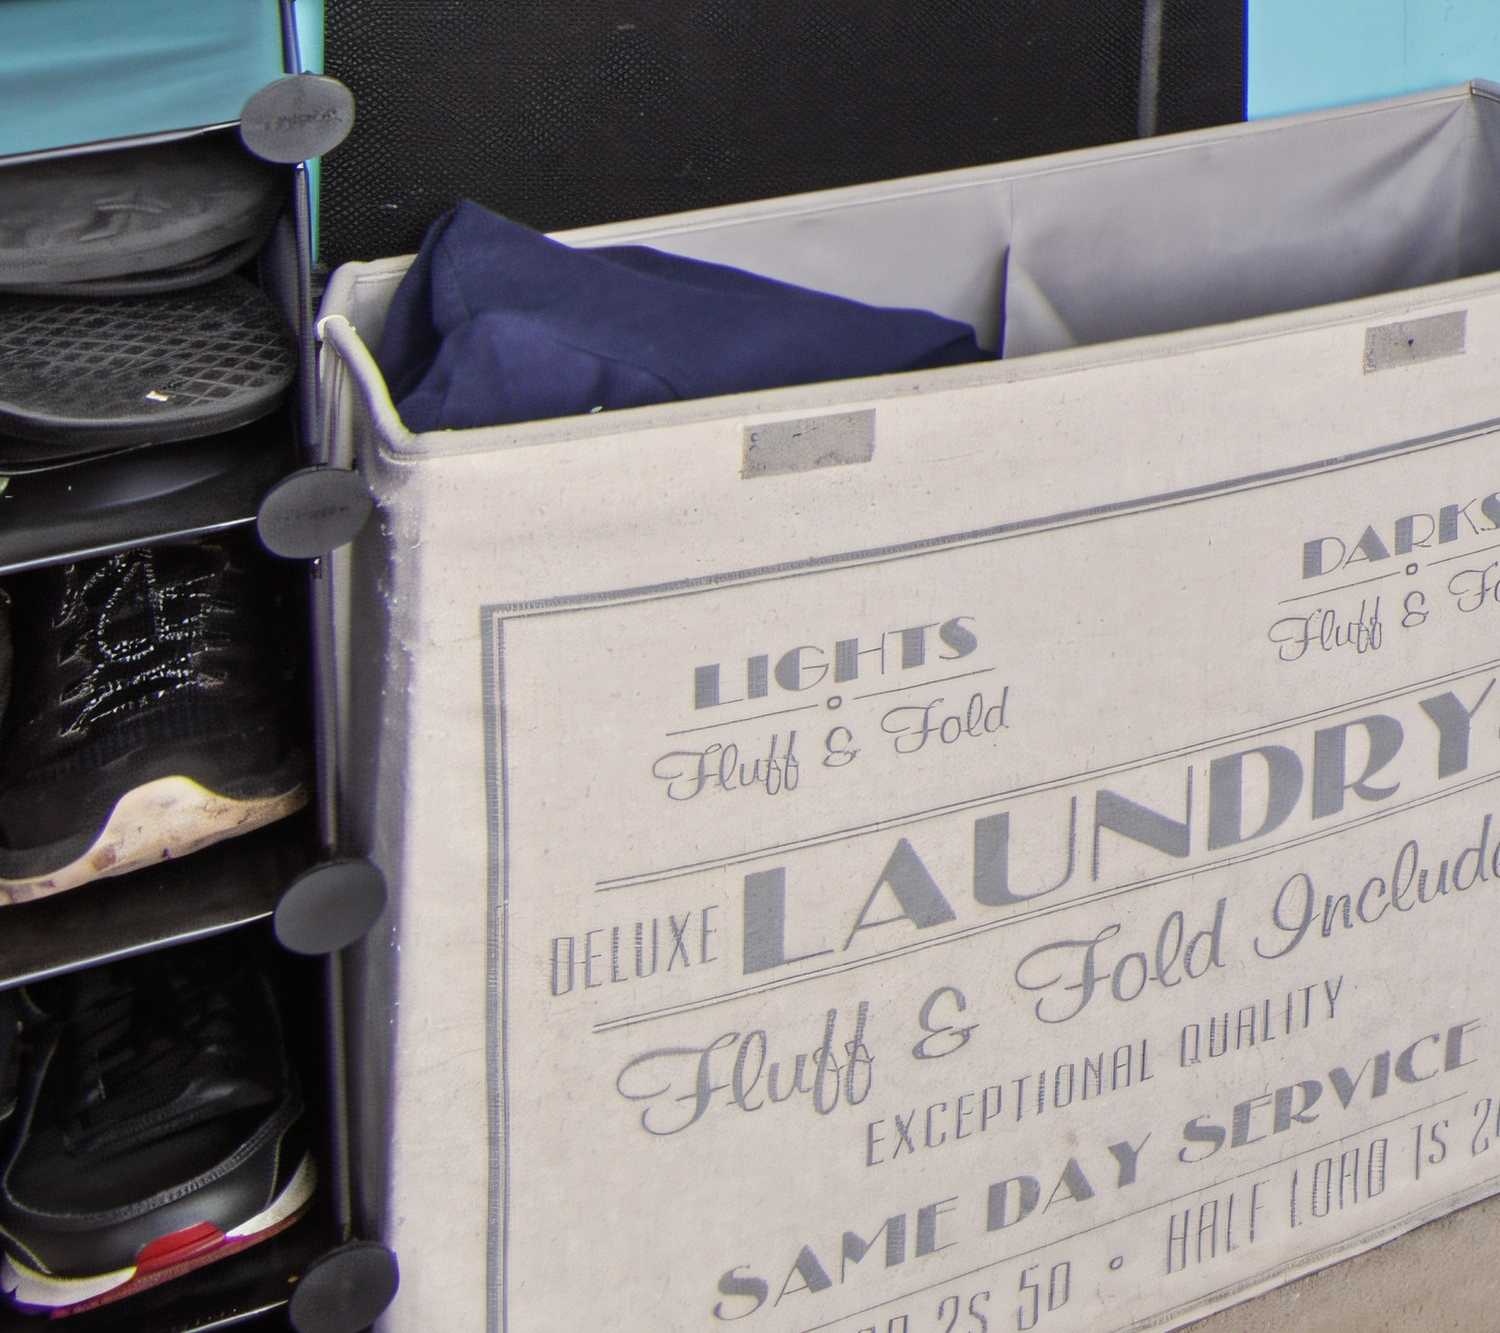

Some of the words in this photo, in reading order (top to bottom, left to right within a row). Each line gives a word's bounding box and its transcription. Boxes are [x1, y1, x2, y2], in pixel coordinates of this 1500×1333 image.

[693, 614, 979, 711] LIGHTS
[1266, 594, 1383, 662] Fluff
[1400, 589, 1430, 629] &
[651, 729, 801, 802] Fluff
[821, 725, 863, 768] &
[879, 684, 1011, 755] Fold
[549, 903, 720, 998] DELUXE
[742, 676, 1498, 976] LAUNDRY
[615, 1000, 876, 1137] Fluff
[911, 985, 981, 1061] &
[1014, 896, 1227, 1025] Fold
[866, 1038, 1156, 1168] EXCEPTIONAL
[1180, 974, 1344, 1069] QUALITY
[712, 1195, 960, 1322] SAME
[985, 1131, 1152, 1233] DAY
[1178, 1017, 1483, 1164] SERVICE
[1166, 1179, 1271, 1276] HALF
